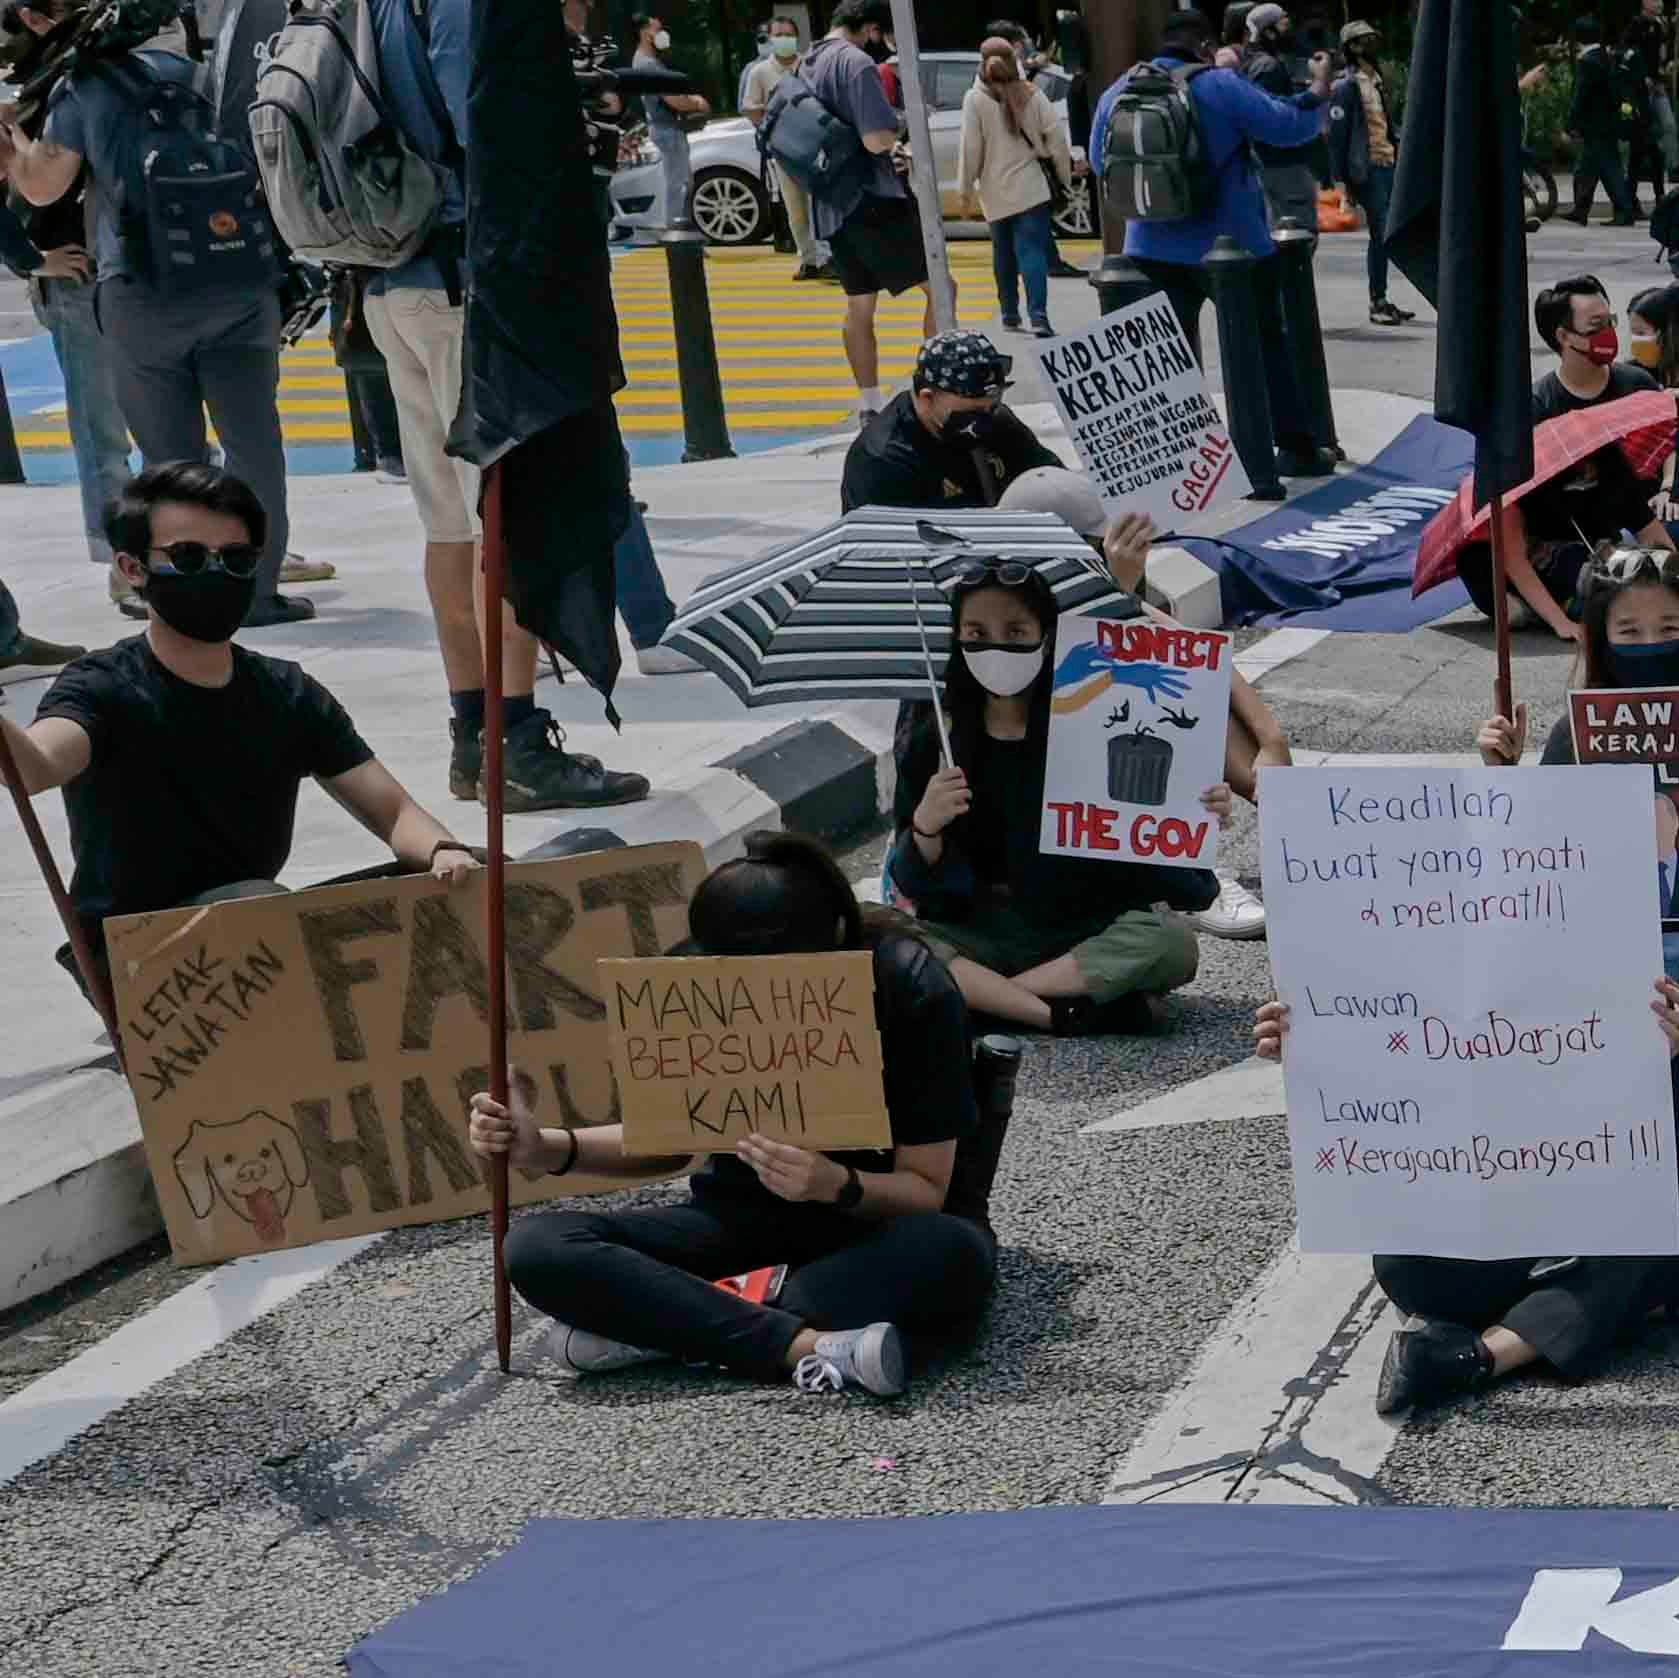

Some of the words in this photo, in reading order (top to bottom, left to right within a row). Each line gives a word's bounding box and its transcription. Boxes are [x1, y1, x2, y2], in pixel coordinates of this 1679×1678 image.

[1040, 340, 1093, 384] KAD
[1087, 304, 1180, 364] LAPORAN
[1056, 337, 1195, 421] KERAJAAN
[1160, 393, 1209, 424] NEGARA
[1161, 407, 1223, 441] EKONOMI
[1171, 431, 1230, 512] GAGAL
[1047, 801, 1121, 851] THE
[1129, 813, 1209, 859] GOV
[1328, 783, 1514, 826] Keadilan
[1281, 837, 1379, 884] buat
[1398, 846, 1483, 888] yang
[1503, 836, 1587, 874] mati
[298, 862, 688, 1061] FART
[128, 943, 225, 1043] LETAK
[140, 937, 287, 1100] JAWATAN
[615, 976, 763, 1031] MANA
[769, 976, 857, 1025] HAK
[1305, 985, 1420, 1019] Lawan
[626, 1028, 861, 1081] BERSUARA
[685, 1079, 807, 1136] KAMI
[1318, 1089, 1421, 1125] Lawan
